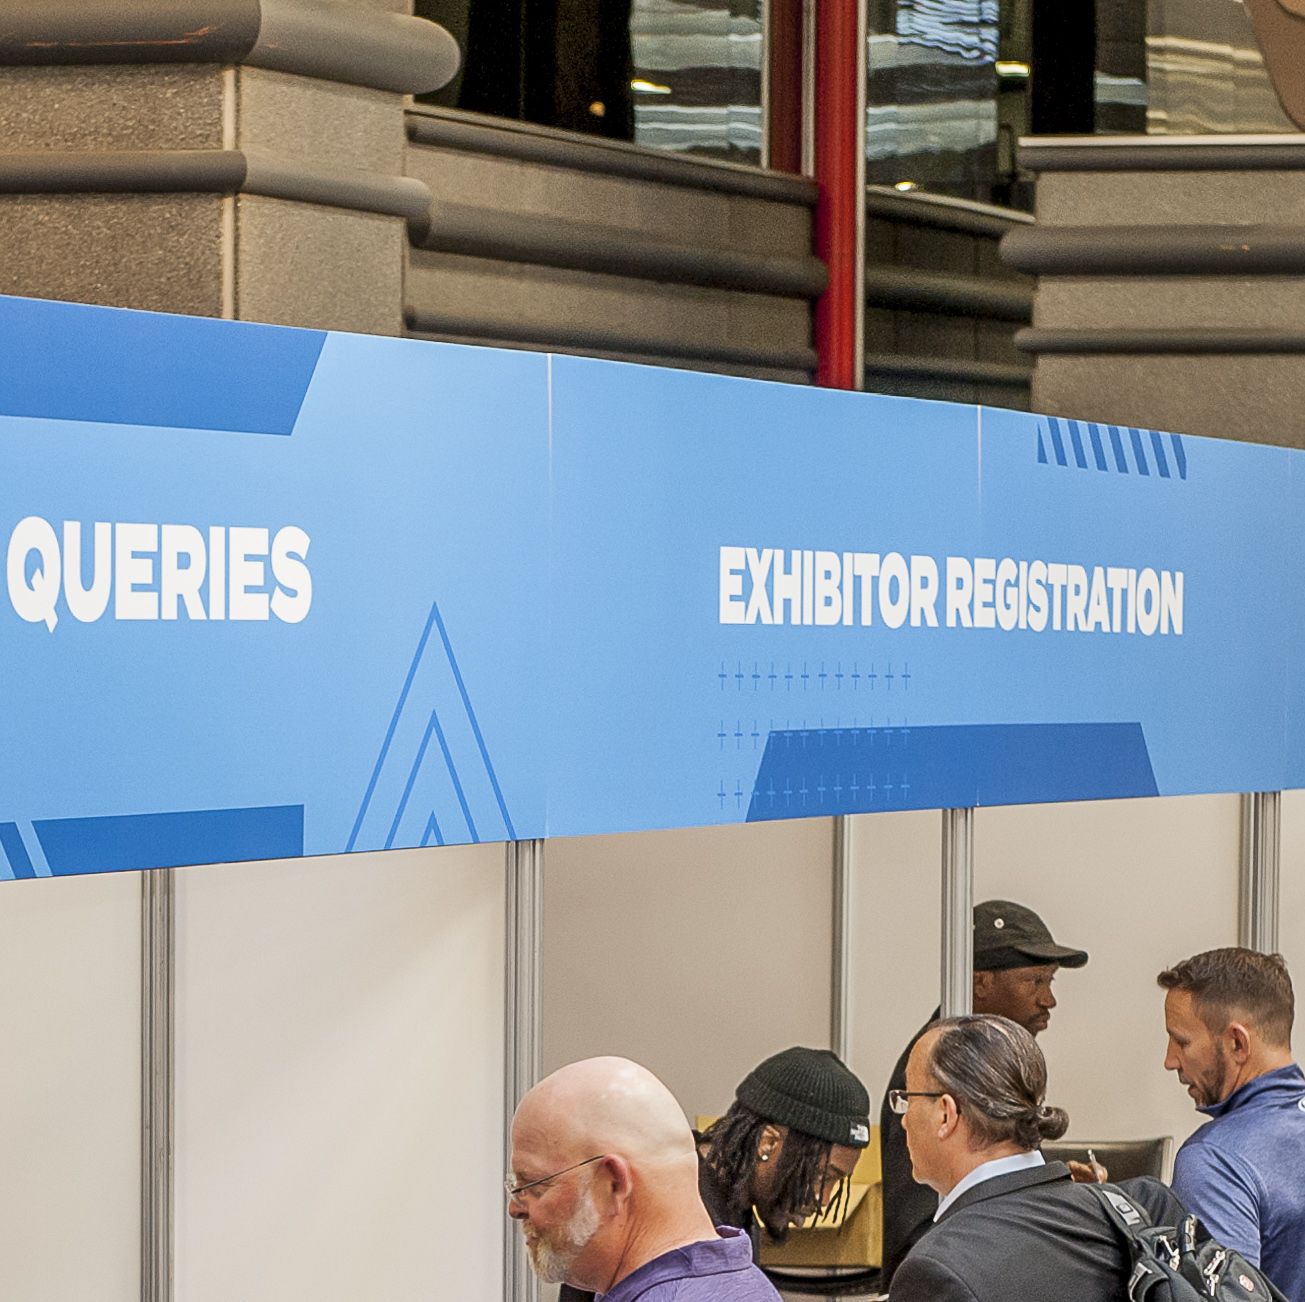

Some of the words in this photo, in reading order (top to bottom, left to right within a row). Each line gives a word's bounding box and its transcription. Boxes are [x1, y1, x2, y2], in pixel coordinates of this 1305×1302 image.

[6, 515, 313, 633] QUERIES
[719, 546, 939, 629] EXHIBITOR
[946, 556, 1184, 636] REGISTRATION
